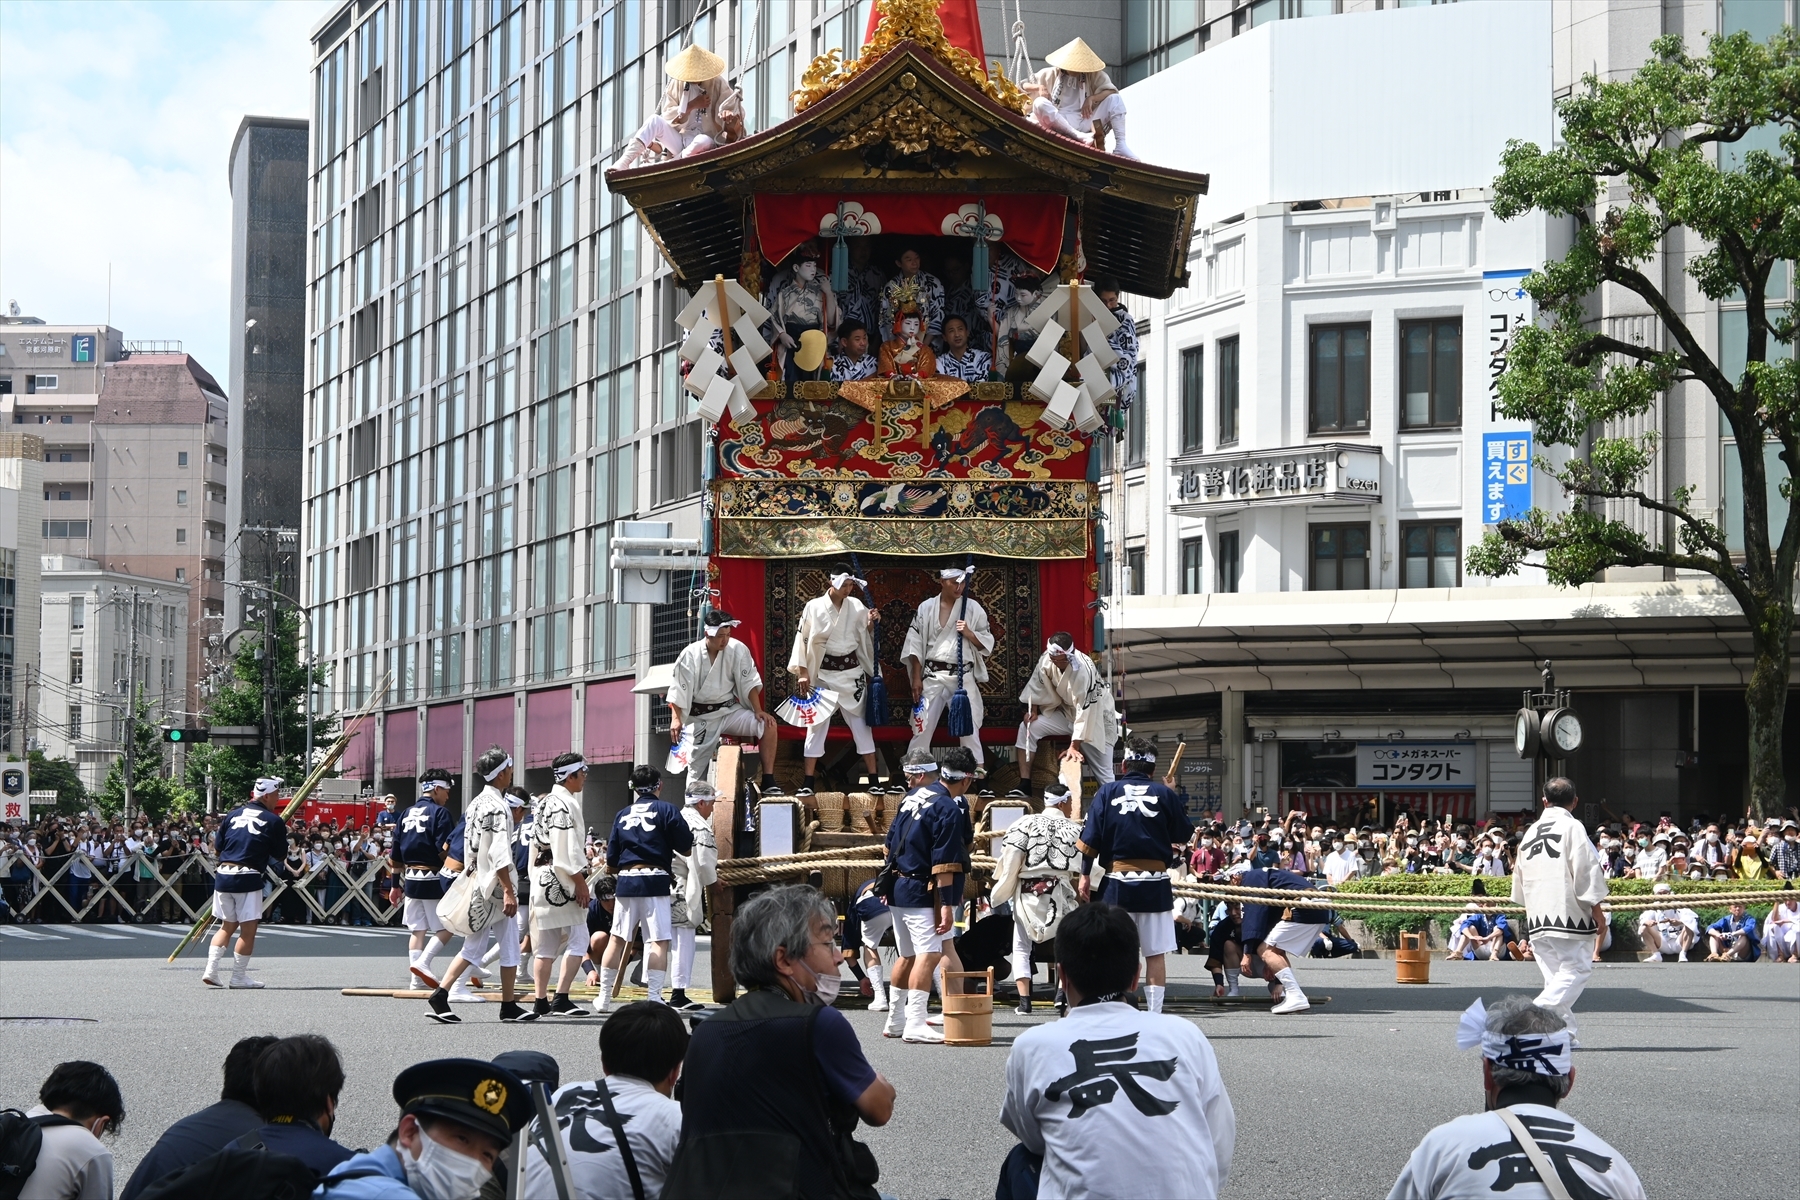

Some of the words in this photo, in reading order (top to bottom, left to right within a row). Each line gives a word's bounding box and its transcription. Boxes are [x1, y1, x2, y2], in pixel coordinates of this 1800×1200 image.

[26, 346, 61, 354] 京都河原町
[1509, 442, 1525, 482] すぐ
[1177, 458, 1327, 499] 池善化粧品店
[1487, 441, 1506, 521] 買えます
[1401, 750, 1461, 759] メガネスーパー
[1373, 763, 1461, 781] コンタクト
[5, 802, 22, 820] 救
[1044, 1031, 1182, 1119] 長
